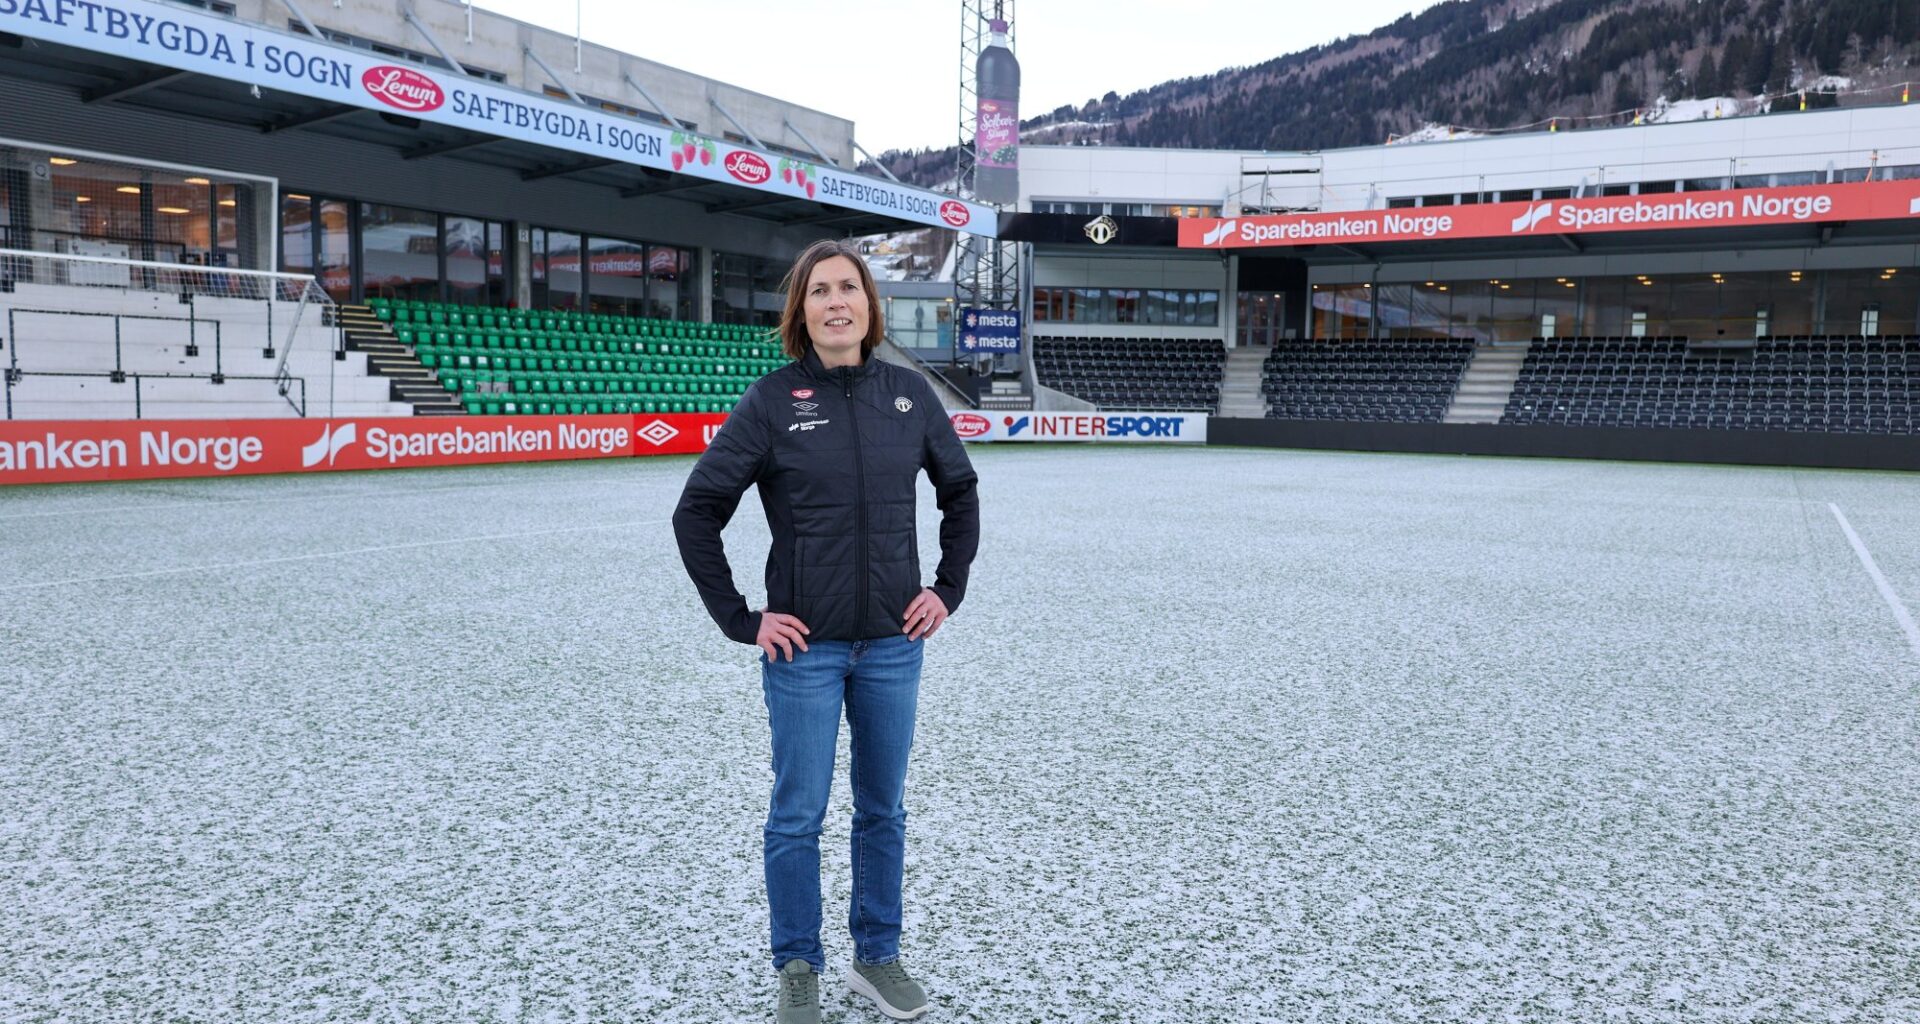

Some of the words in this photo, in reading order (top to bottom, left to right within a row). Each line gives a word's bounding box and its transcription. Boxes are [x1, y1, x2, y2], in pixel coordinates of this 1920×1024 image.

[245, 40, 255, 68] I
[264, 45, 352, 89] SOGN
[366, 69, 437, 108] Lerum
[452, 89, 592, 143] SAFTBYGDA
[596, 123, 603, 144] I
[608, 126, 662, 157] SOGN
[727, 153, 767, 182] Lerum
[822, 176, 897, 209] SAFTBYGDA
[899, 194, 904, 210] I
[905, 198, 937, 217] SOGN
[1558, 198, 1734, 229] Sparebanken
[1742, 194, 1832, 219] Norge
[1240, 217, 1377, 244] Sparebanken
[1383, 214, 1453, 236] Norge
[979, 315, 1017, 327] mesta
[979, 336, 1017, 348] mesta
[365, 425, 552, 463] Sparebanken
[558, 423, 629, 452] Norge
[1033, 415, 1184, 437] INTERSPORT
[140, 430, 263, 470] Norge
